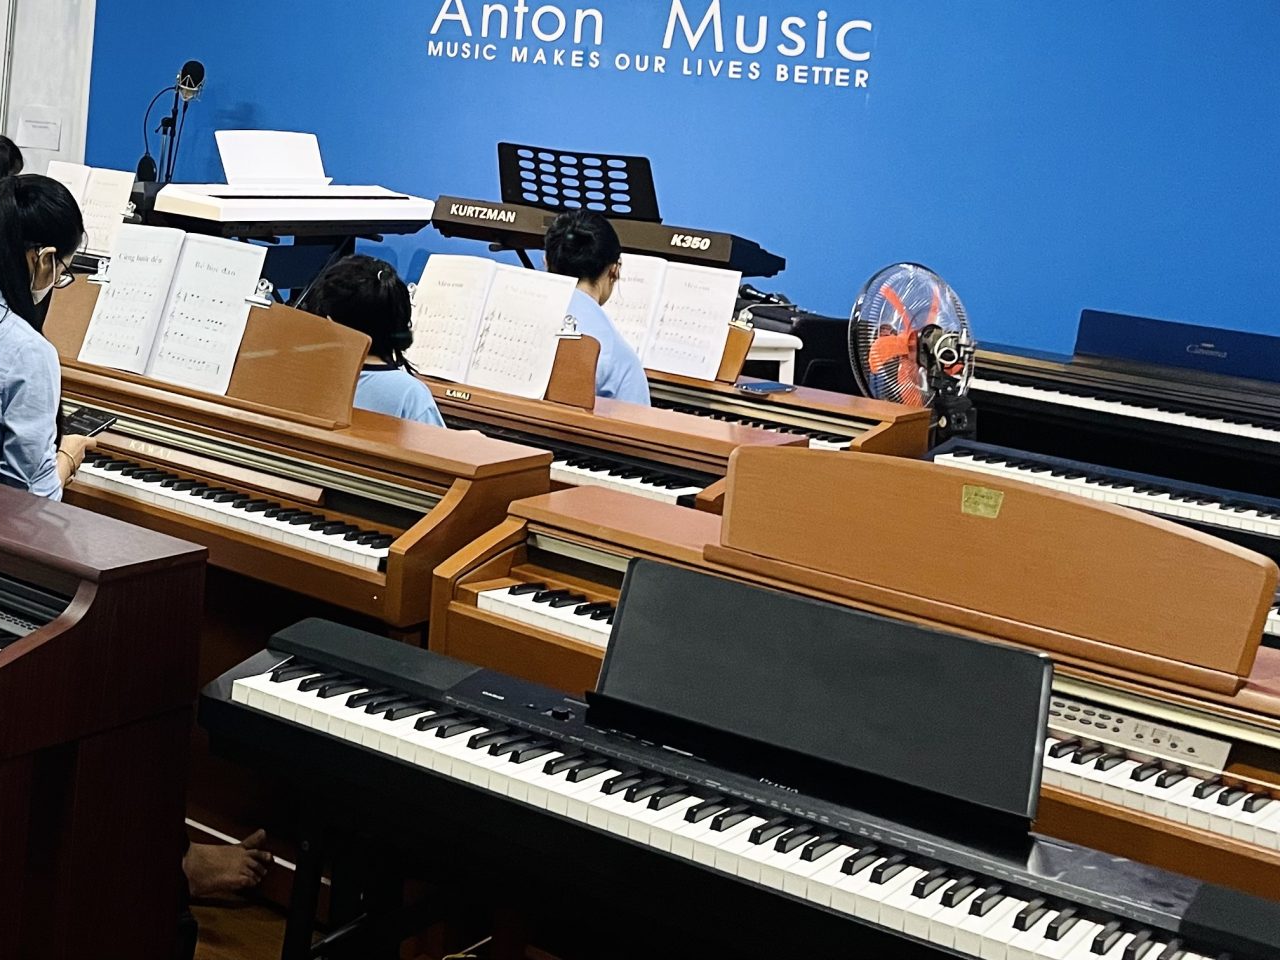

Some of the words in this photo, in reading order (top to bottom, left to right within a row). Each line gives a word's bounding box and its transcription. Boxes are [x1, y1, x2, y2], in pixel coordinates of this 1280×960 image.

[427, 40, 497, 61] MUSIC
[511, 46, 600, 69] MAKES
[614, 53, 666, 73] OUR
[682, 57, 760, 80] LIVES
[776, 63, 869, 88] BETTER
[450, 203, 516, 223] KURTZMAN
[670, 233, 711, 251] K350
[445, 388, 470, 401] KAWAI
